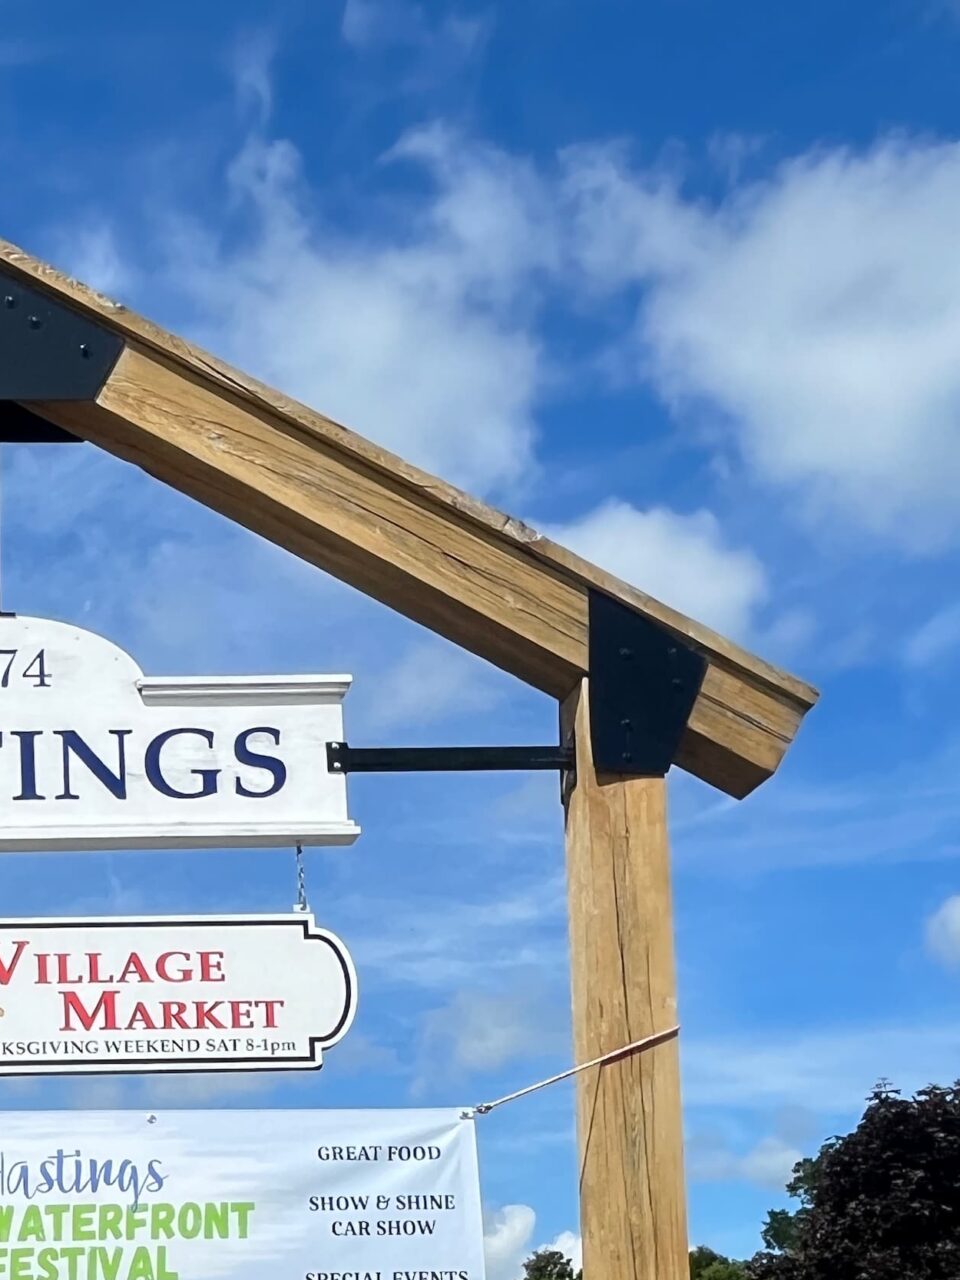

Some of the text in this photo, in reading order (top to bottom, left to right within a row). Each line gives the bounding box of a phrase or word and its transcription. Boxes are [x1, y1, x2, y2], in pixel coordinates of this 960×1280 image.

[104, 1039, 201, 1054] WEEKEND
[205, 1038, 241, 1052] SAT
[245, 1037, 297, 1055] 8-1pm
[317, 1145, 442, 1161] GREAT FOOD
[309, 1195, 456, 1211] SHOW & SHINE
[331, 1221, 436, 1236] CAR SHOW
